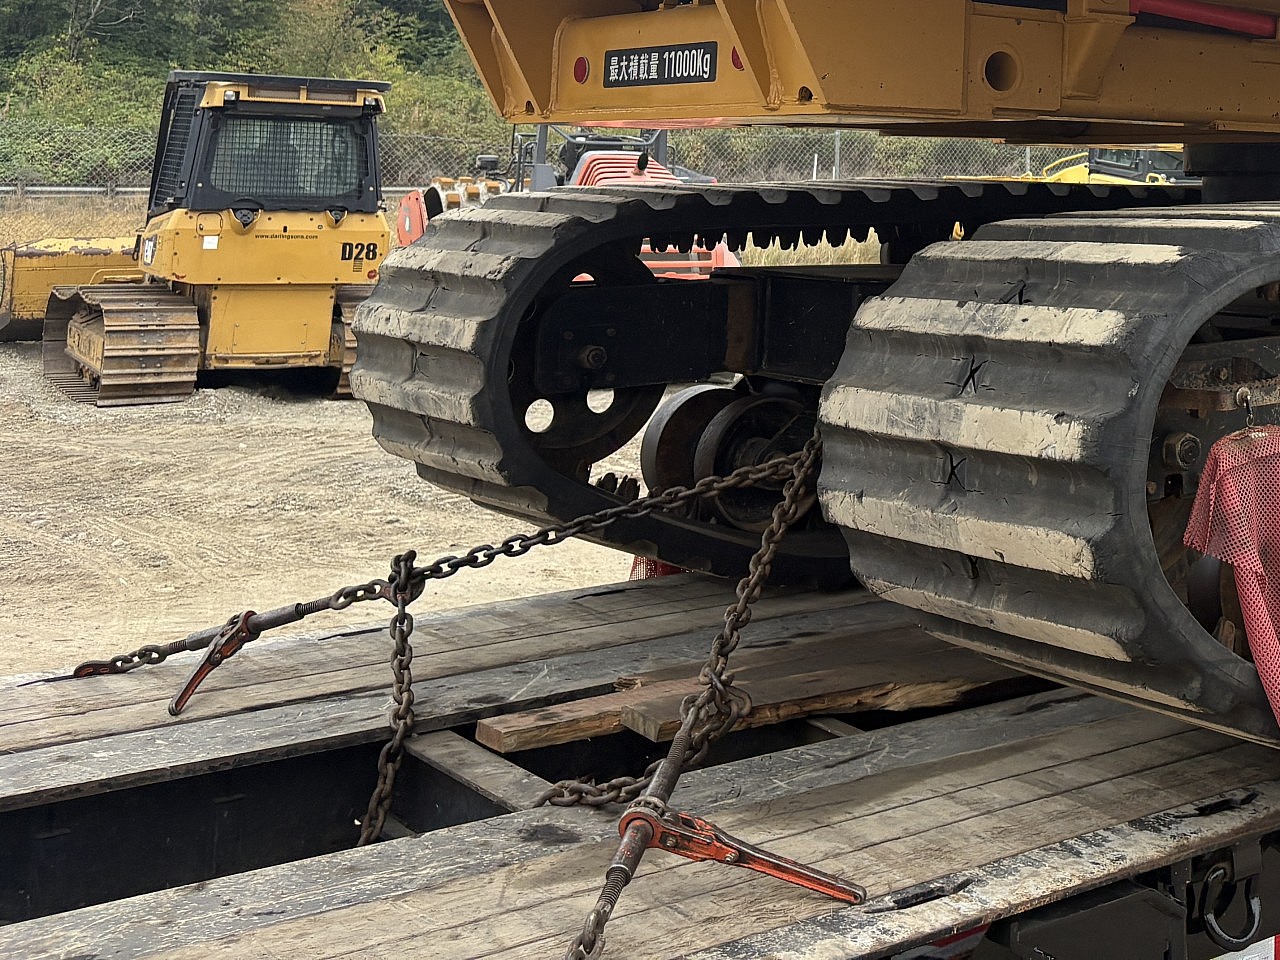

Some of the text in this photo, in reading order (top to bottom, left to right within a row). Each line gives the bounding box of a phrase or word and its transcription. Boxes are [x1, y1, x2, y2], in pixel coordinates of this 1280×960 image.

[609, 48, 711, 82] 最大積載量 11000Kg
[341, 242, 378, 261] D28
